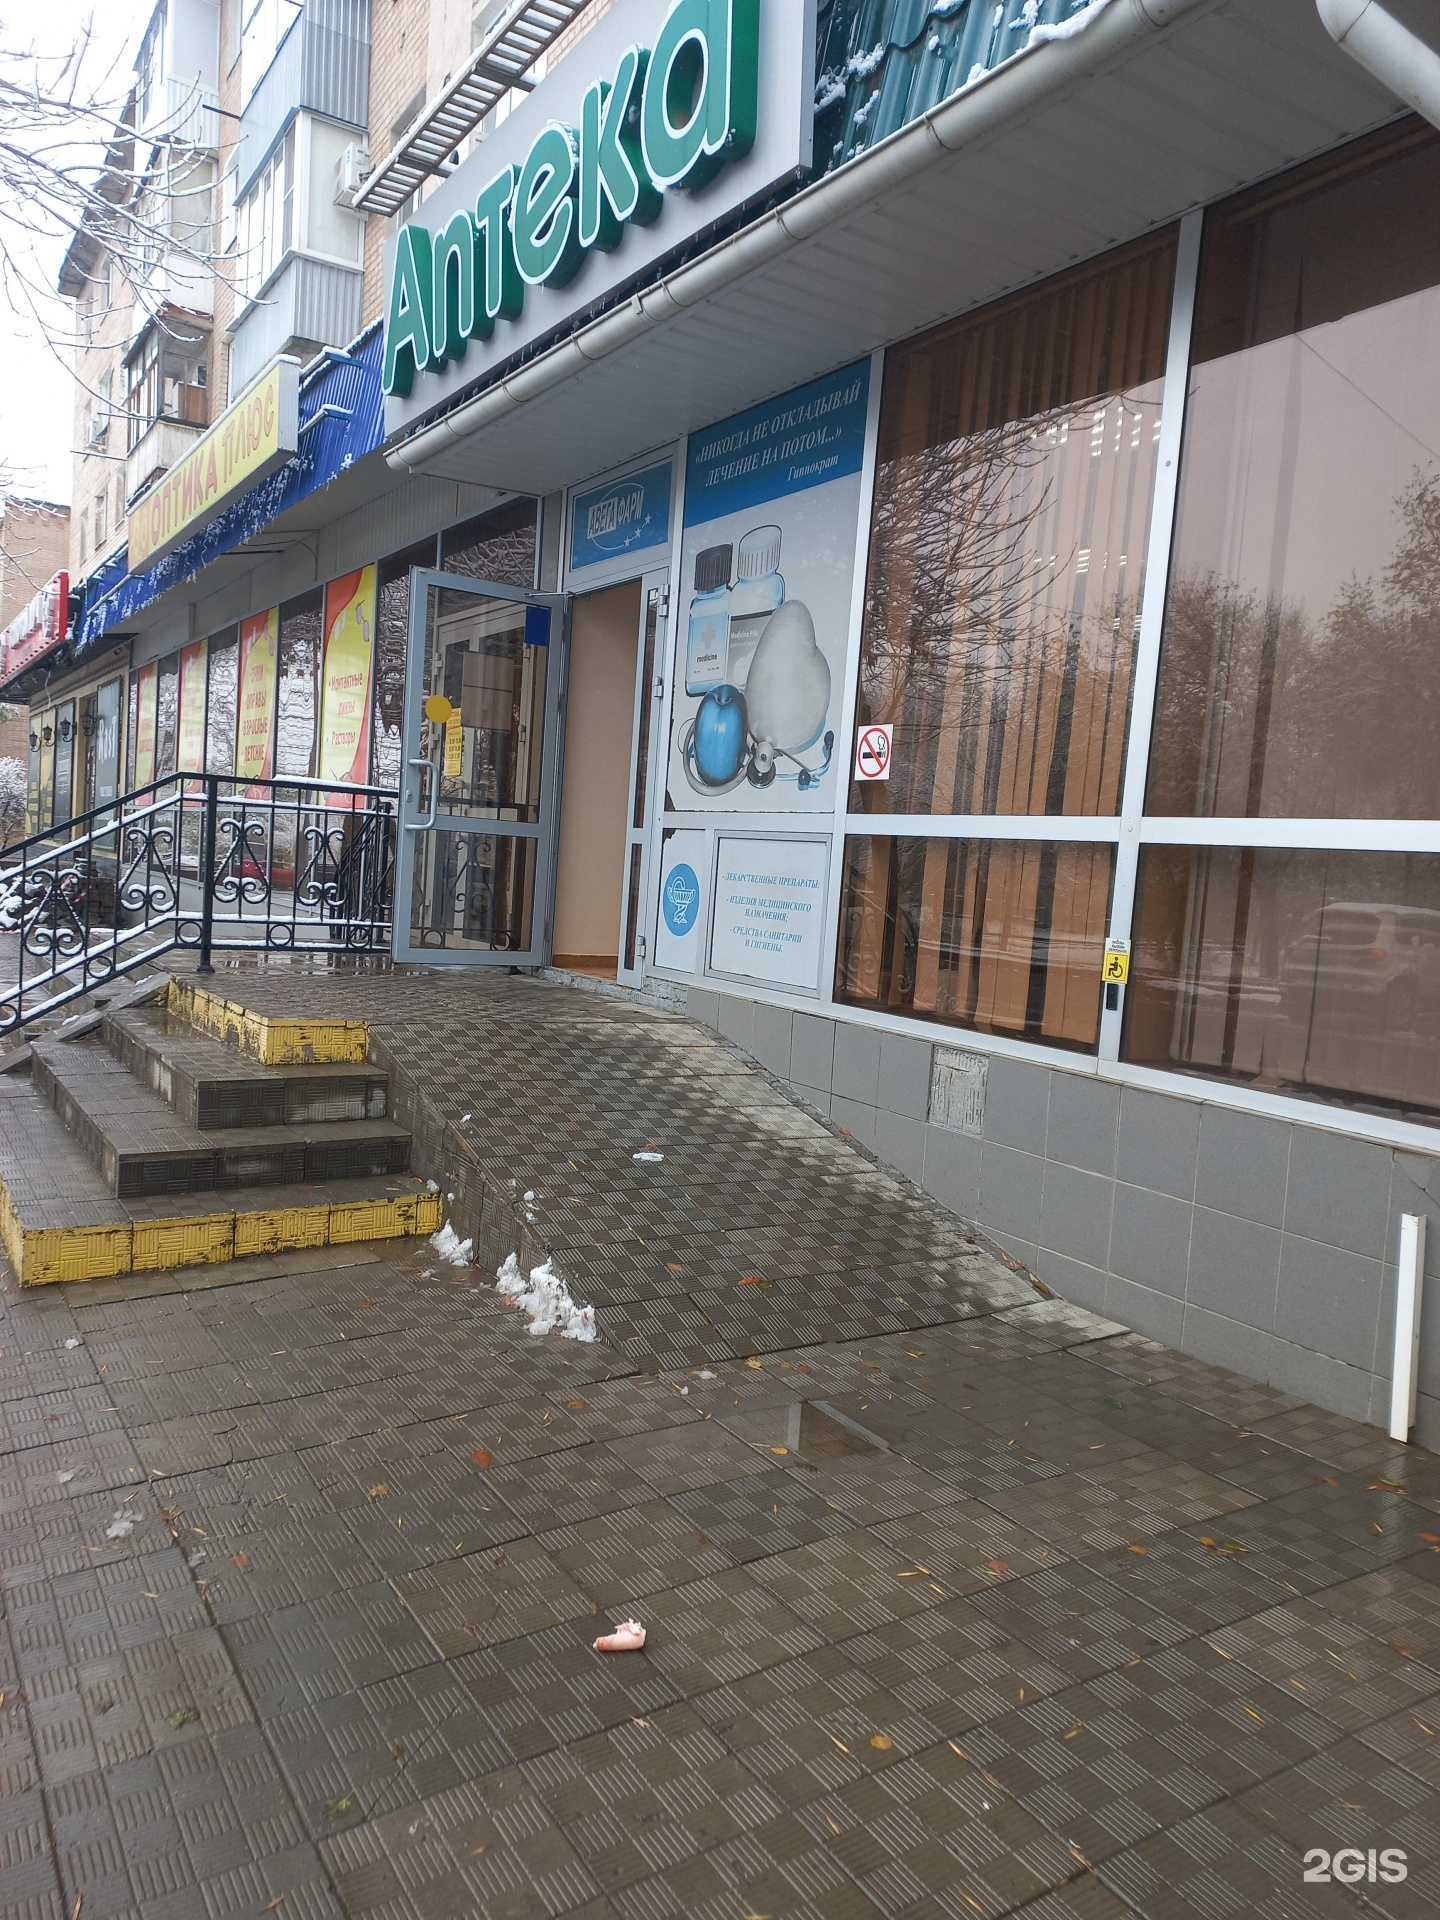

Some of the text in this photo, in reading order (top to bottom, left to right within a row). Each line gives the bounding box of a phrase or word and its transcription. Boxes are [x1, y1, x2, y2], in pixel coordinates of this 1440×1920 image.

[382, 0, 757, 396] Аптека
[695, 378, 862, 465] «НИКОГДА НЕ ОТКЛАДЫВАЙ
[151, 384, 275, 546] ОПТИКА ПЛЮС
[705, 452, 760, 487] ЛЕЧЕНИЕ
[761, 447, 778, 466] НА
[788, 455, 839, 482] Гиппократ
[733, 926, 803, 944] СРЕДСТВА САНИТАРИИ
